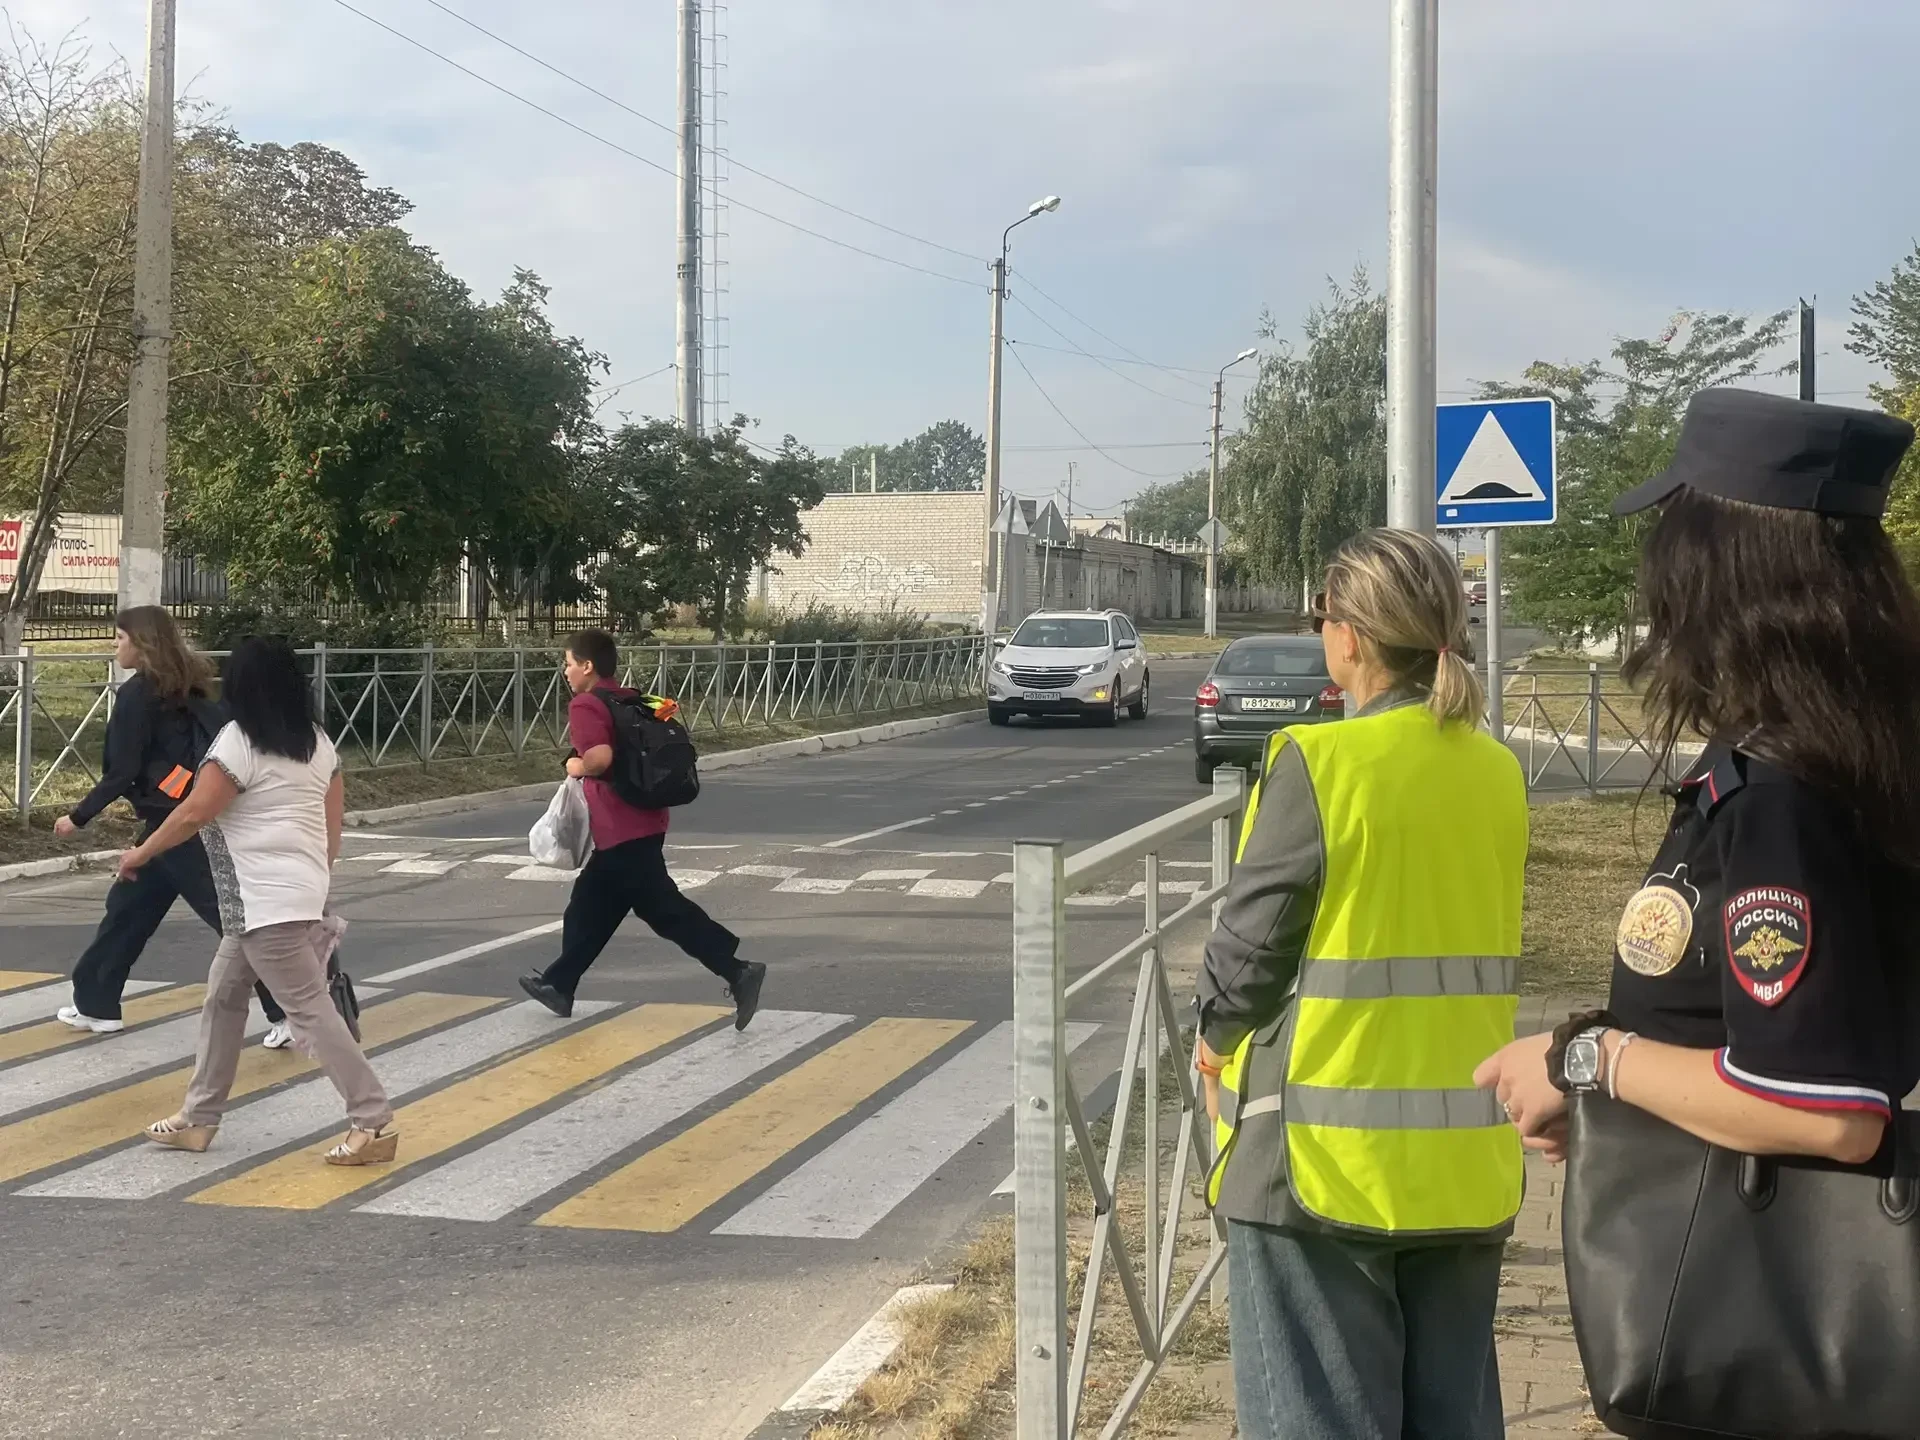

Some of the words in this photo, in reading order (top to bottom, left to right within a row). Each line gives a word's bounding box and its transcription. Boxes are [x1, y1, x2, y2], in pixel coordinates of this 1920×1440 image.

[0, 529, 17, 551] 20
[60, 540, 87, 550] ГОЛОС
[62, 556, 86, 566] СИЛА
[1728, 889, 1803, 918] ПОЛИЦИЯ
[1734, 908, 1799, 936] РОССИЯ
[1753, 980, 1783, 1001] МВД
